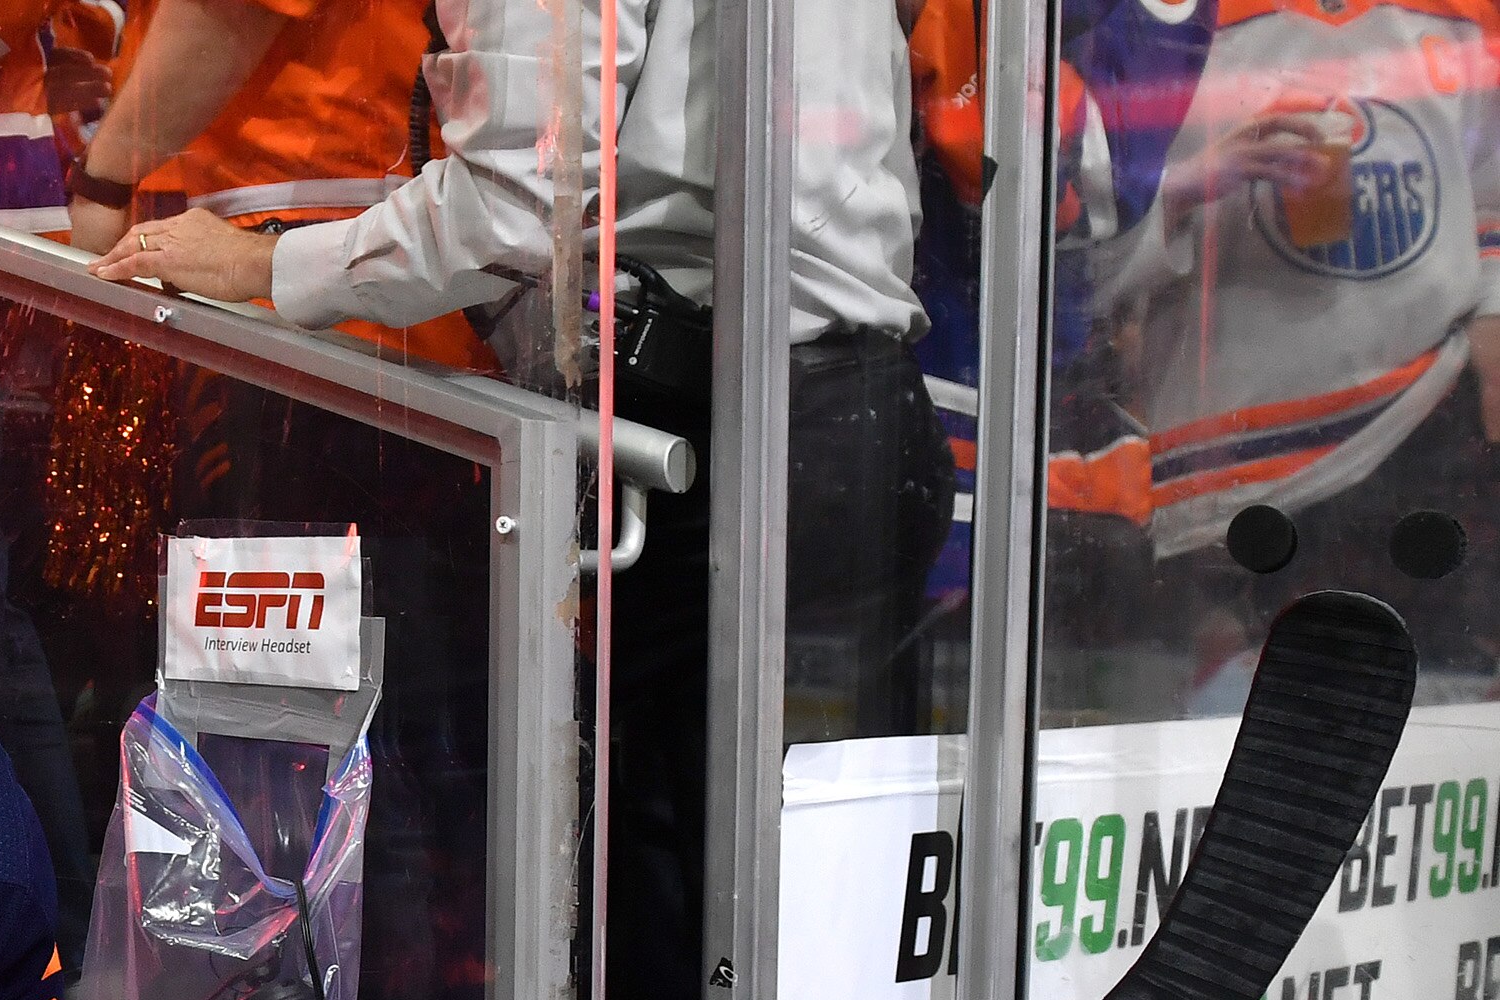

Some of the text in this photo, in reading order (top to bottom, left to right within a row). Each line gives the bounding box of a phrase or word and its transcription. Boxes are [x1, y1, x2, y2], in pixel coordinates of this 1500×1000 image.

[1350, 160, 1427, 270] ERS
[195, 571, 326, 630] ESPN
[204, 636, 312, 655] Interview Headset
